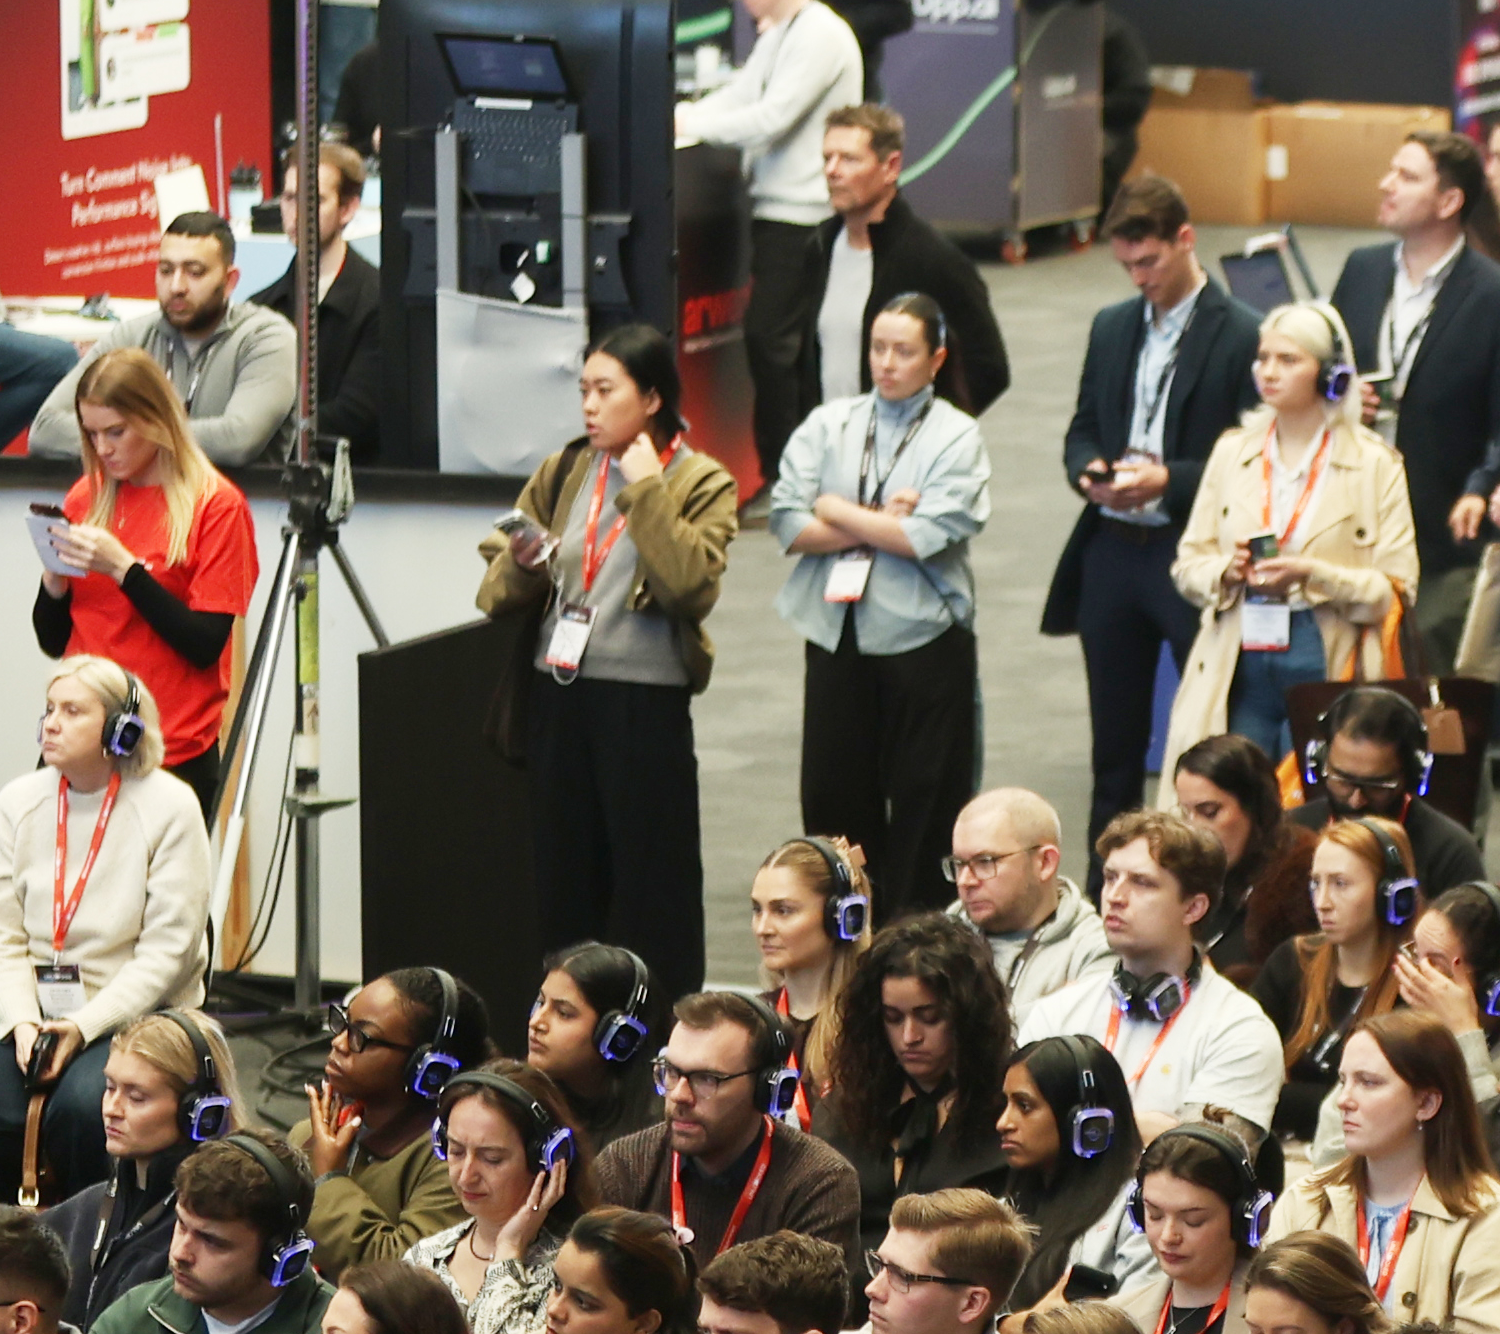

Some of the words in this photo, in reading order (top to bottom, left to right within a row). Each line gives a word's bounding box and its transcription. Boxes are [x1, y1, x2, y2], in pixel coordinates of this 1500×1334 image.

[60, 170, 85, 199] Turn
[85, 164, 137, 194] Comment
[71, 197, 139, 229] Performance
